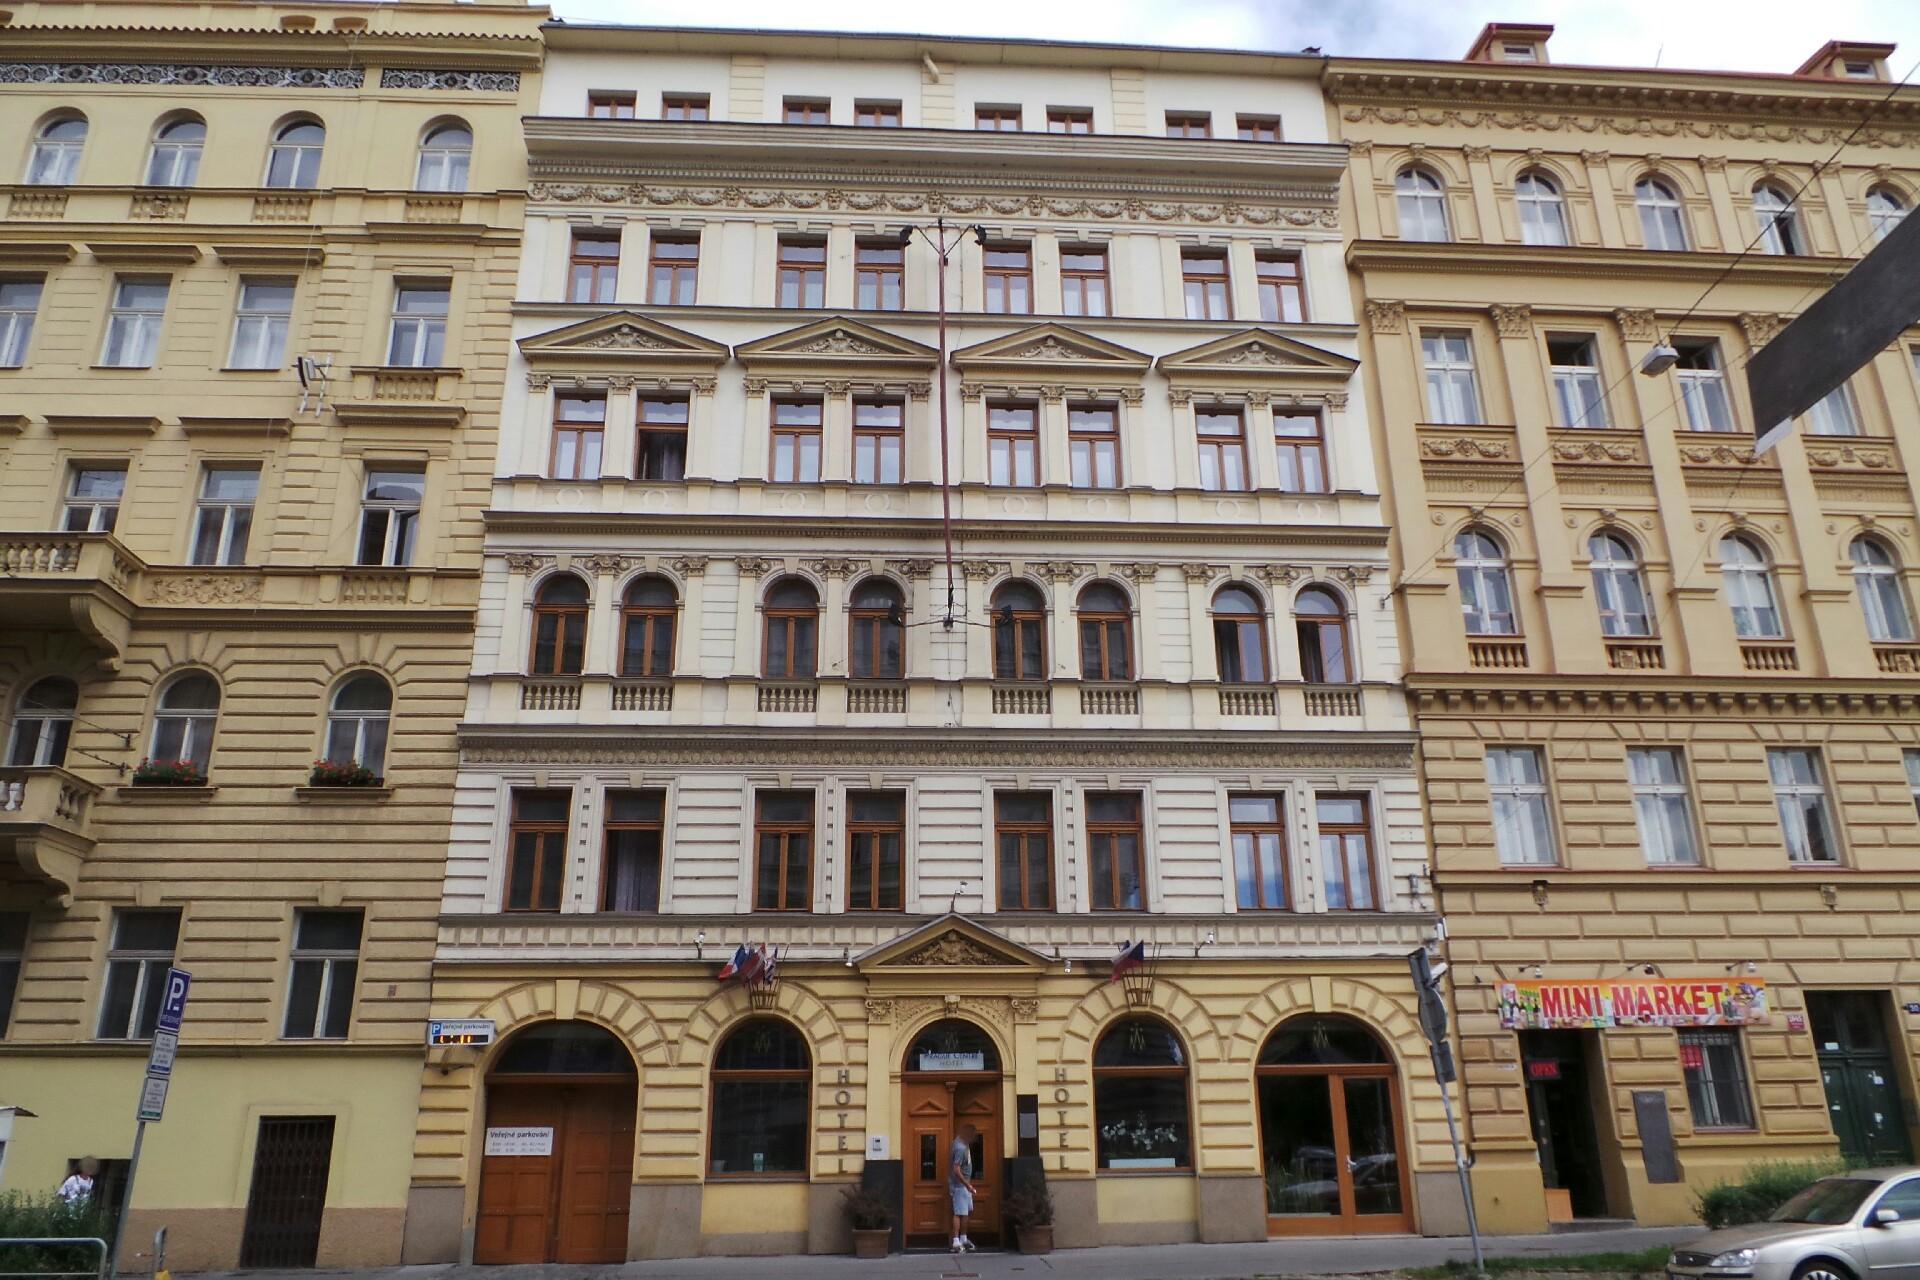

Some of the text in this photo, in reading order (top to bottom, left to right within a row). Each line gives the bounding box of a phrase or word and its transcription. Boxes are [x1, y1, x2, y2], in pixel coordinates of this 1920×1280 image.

[167, 977, 184, 1010] P
[1539, 984, 1724, 1018] MINI MARKET
[432, 1023, 441, 1034] P
[490, 1130, 515, 1139] Veřejné
[835, 1069, 851, 1174] HOTEL
[1055, 1067, 1070, 1170] HOTEL
